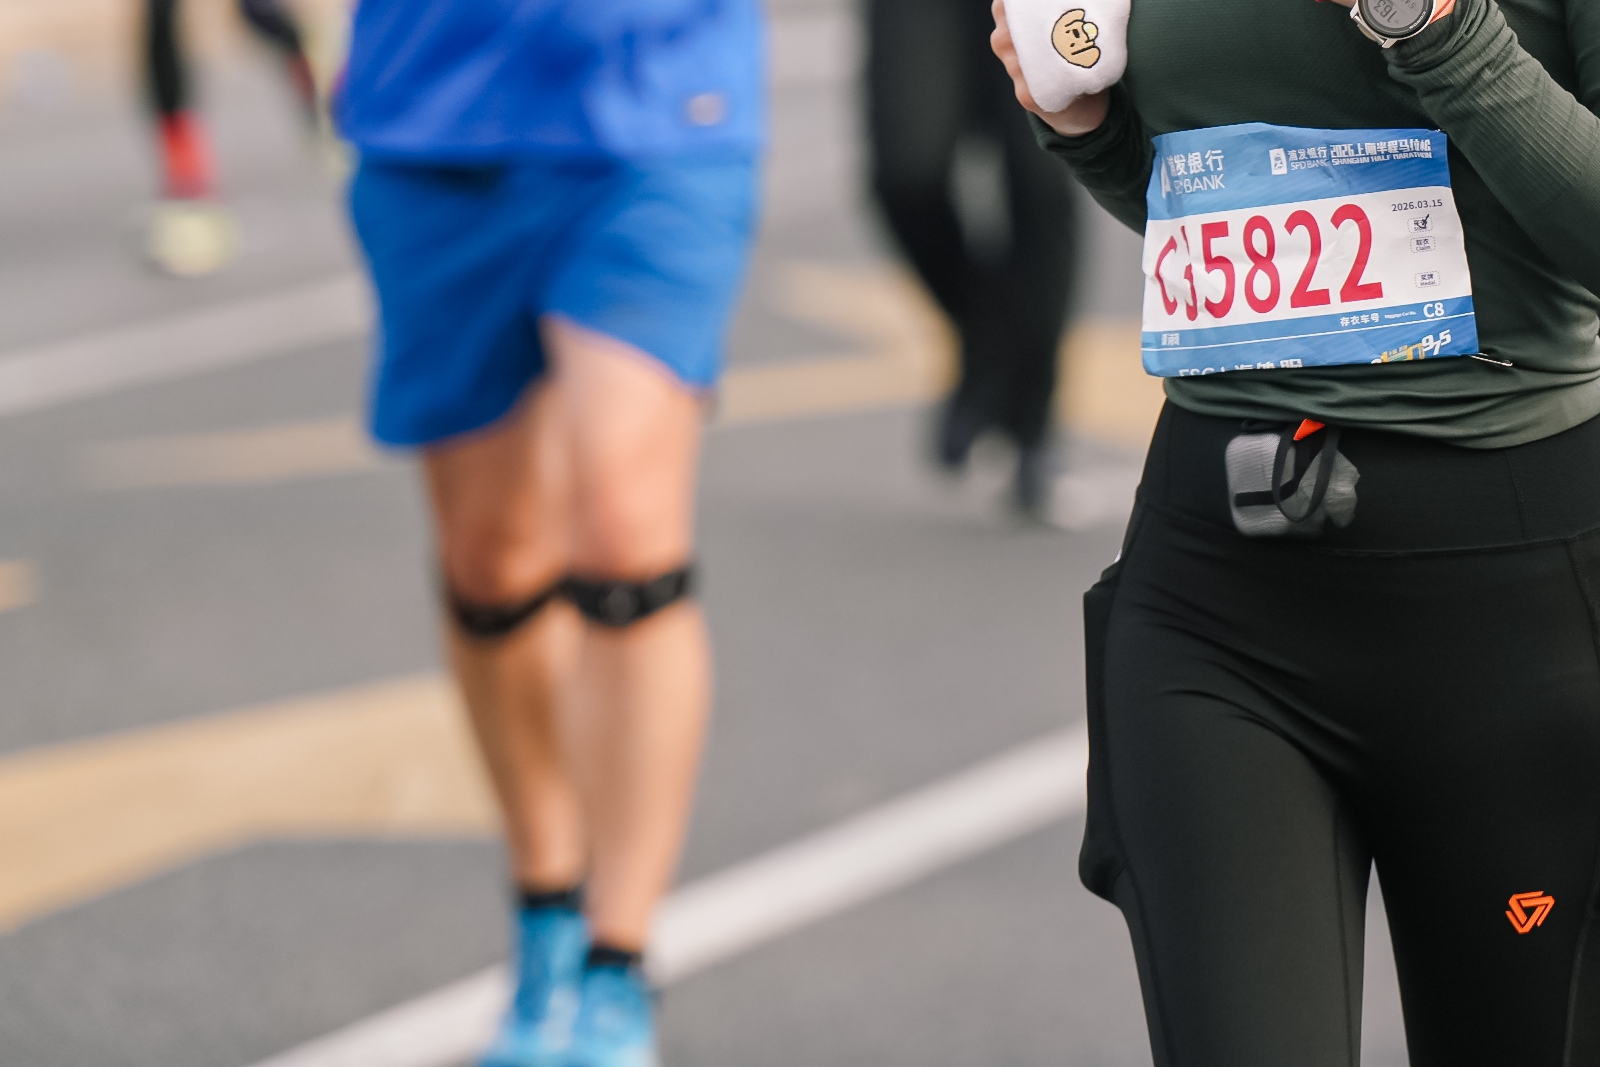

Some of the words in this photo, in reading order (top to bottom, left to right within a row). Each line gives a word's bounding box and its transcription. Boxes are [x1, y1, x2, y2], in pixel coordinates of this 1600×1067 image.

[1184, 174, 1225, 193] BANK
[1391, 199, 1443, 212] 2026.03.15
[1423, 302, 1445, 318] C8
[1340, 313, 1380, 327] 存衣车号
